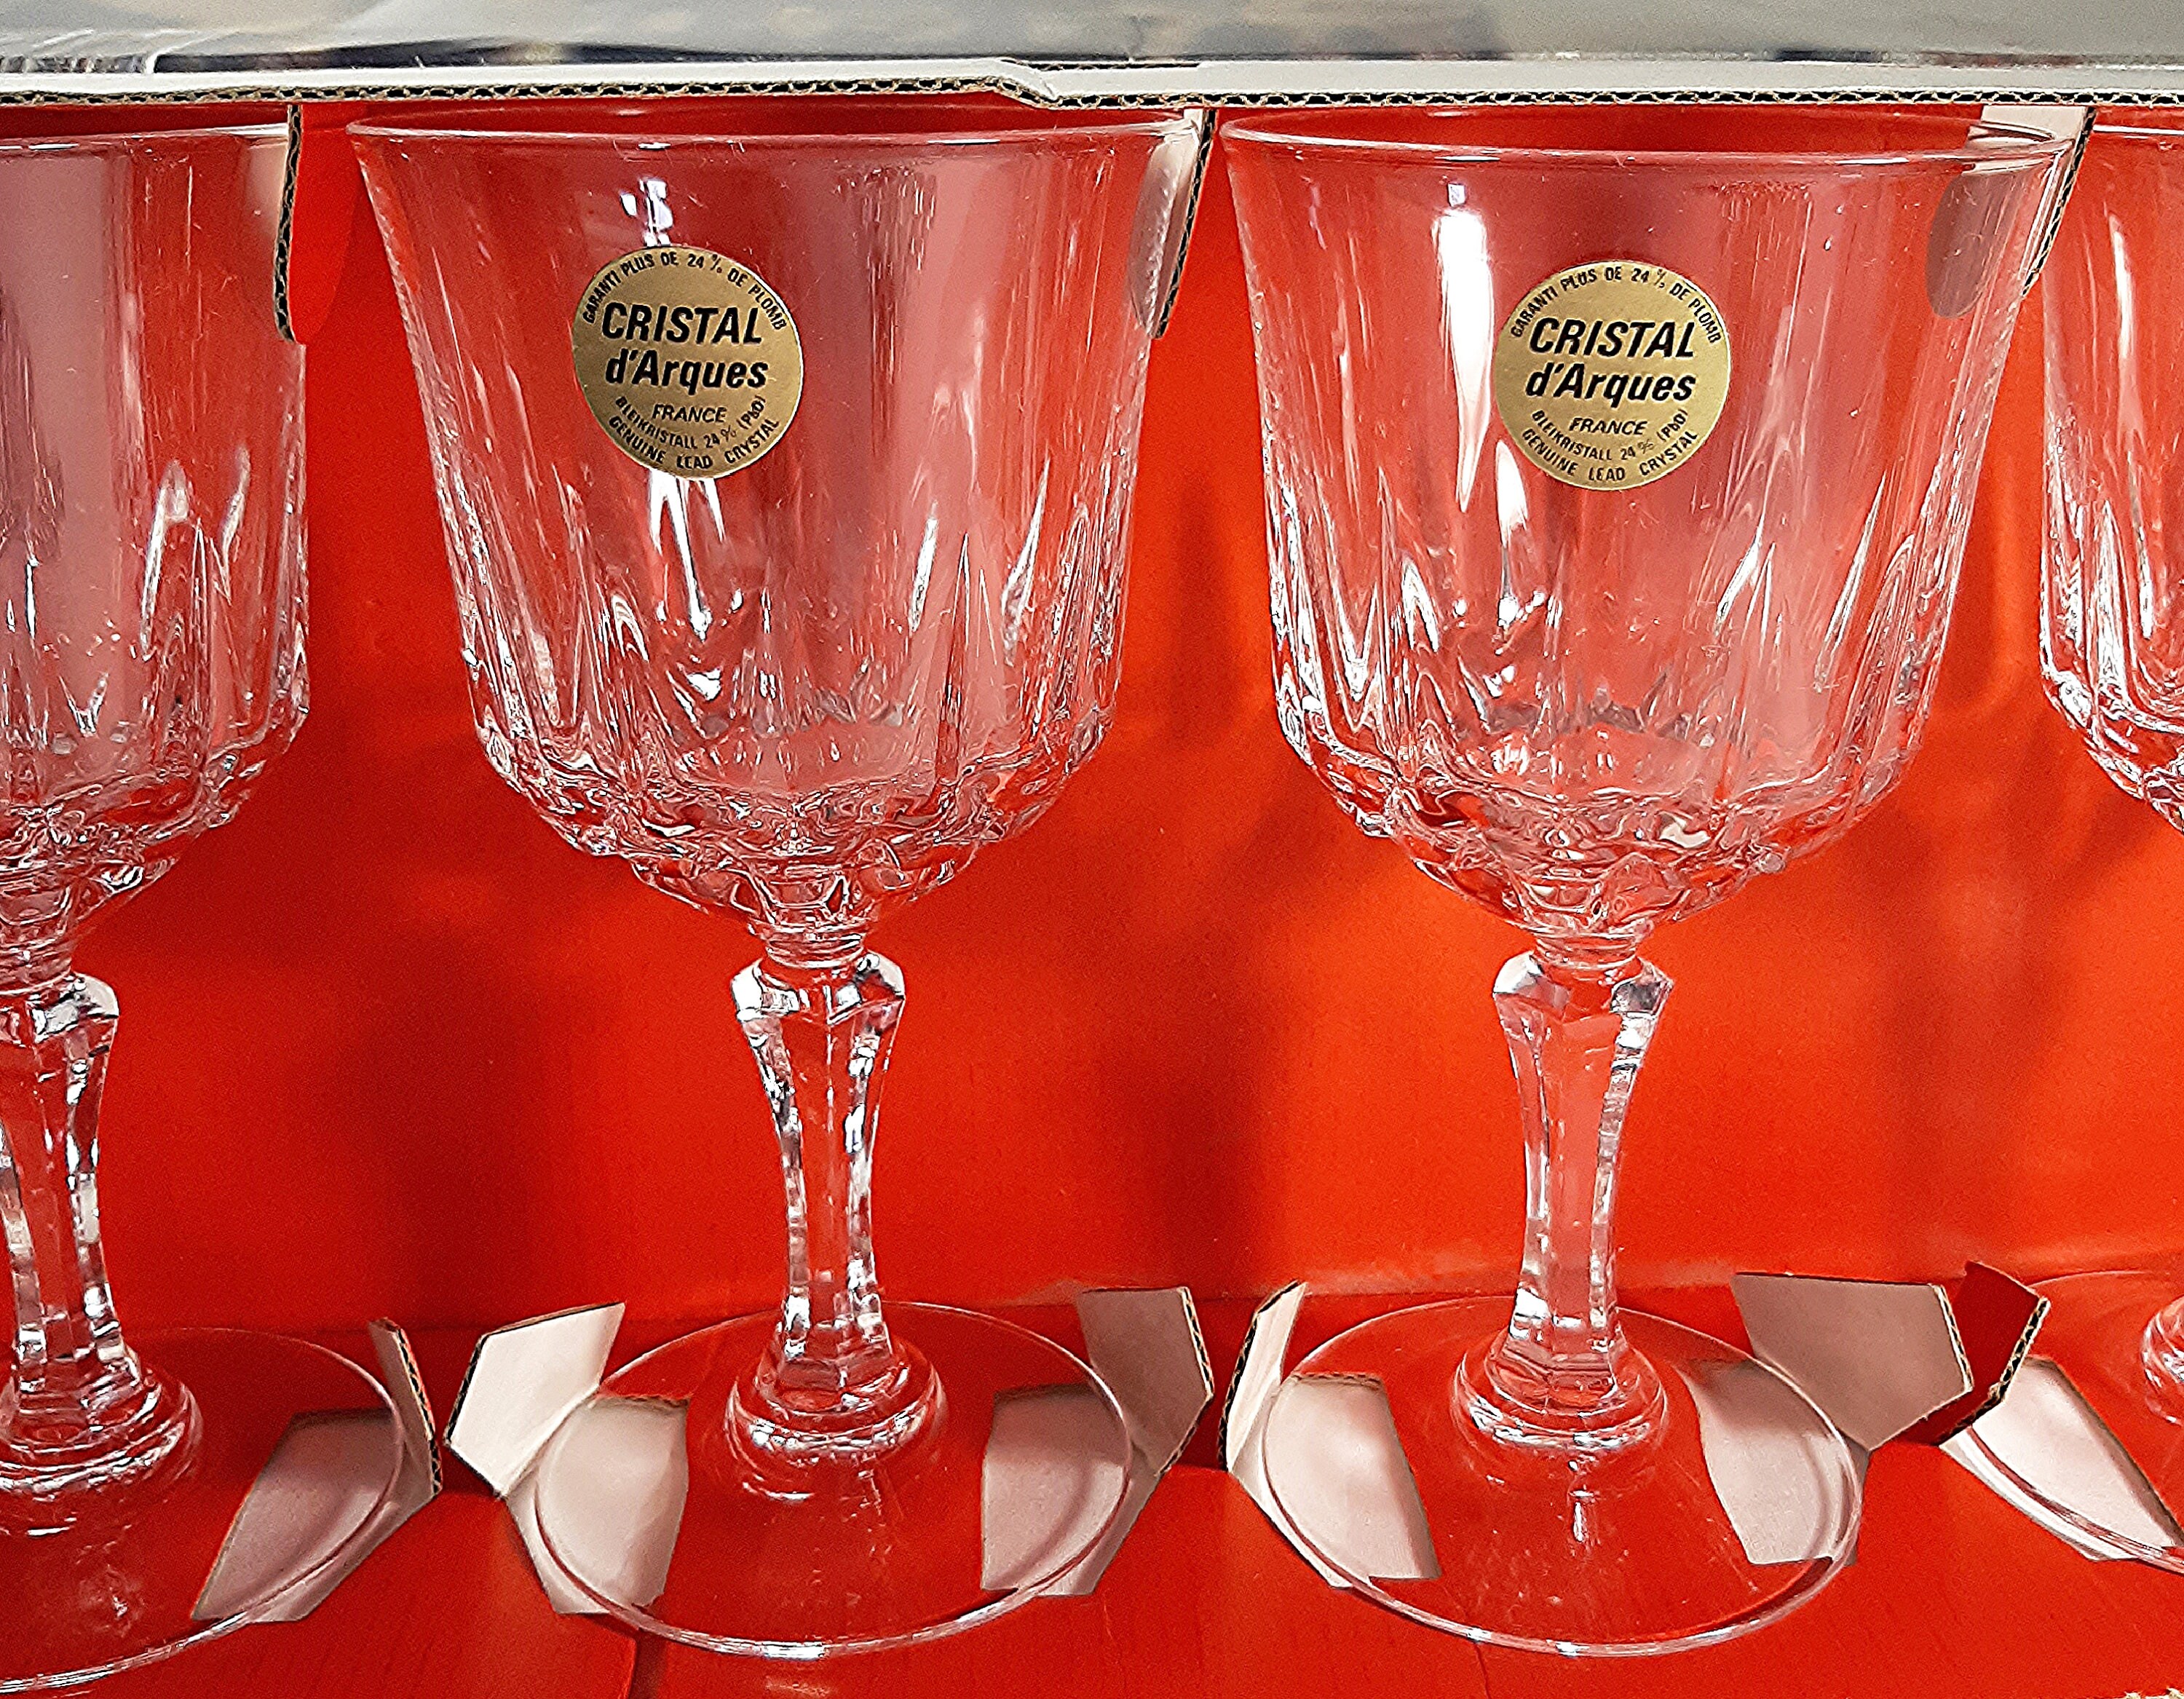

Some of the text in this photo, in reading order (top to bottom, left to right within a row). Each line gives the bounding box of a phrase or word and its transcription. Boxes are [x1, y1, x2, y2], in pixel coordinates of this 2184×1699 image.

[583, 270, 621, 323] GARANTI
[622, 254, 654, 276] PLUS
[661, 252, 678, 266] DE
[687, 254, 704, 269] 24
[728, 268, 748, 287] DE
[748, 288, 787, 330] PLOMB
[1511, 286, 1558, 337] GARANTI
[1561, 269, 1597, 291] PLUS
[1605, 266, 1622, 280] DE
[1631, 268, 1650, 282] 24
[1669, 282, 1690, 301] DE
[1688, 298, 1721, 344] PLOMB
[602, 302, 762, 344] CRISTAL
[1530, 317, 1695, 357] CRISTAL
[616, 396, 697, 449] BLEIKRISTALL
[705, 433, 720, 448] 24
[652, 405, 727, 422] FRANCE
[1532, 410, 1612, 460] BLEIKRISTALL
[1621, 446, 1636, 459] 24
[1569, 418, 1647, 435] FRANCE
[609, 416, 779, 469] GENUINE LEAD CRYSTAL
[1522, 429, 1698, 481] GENUINE LEAD CRYSTAL
